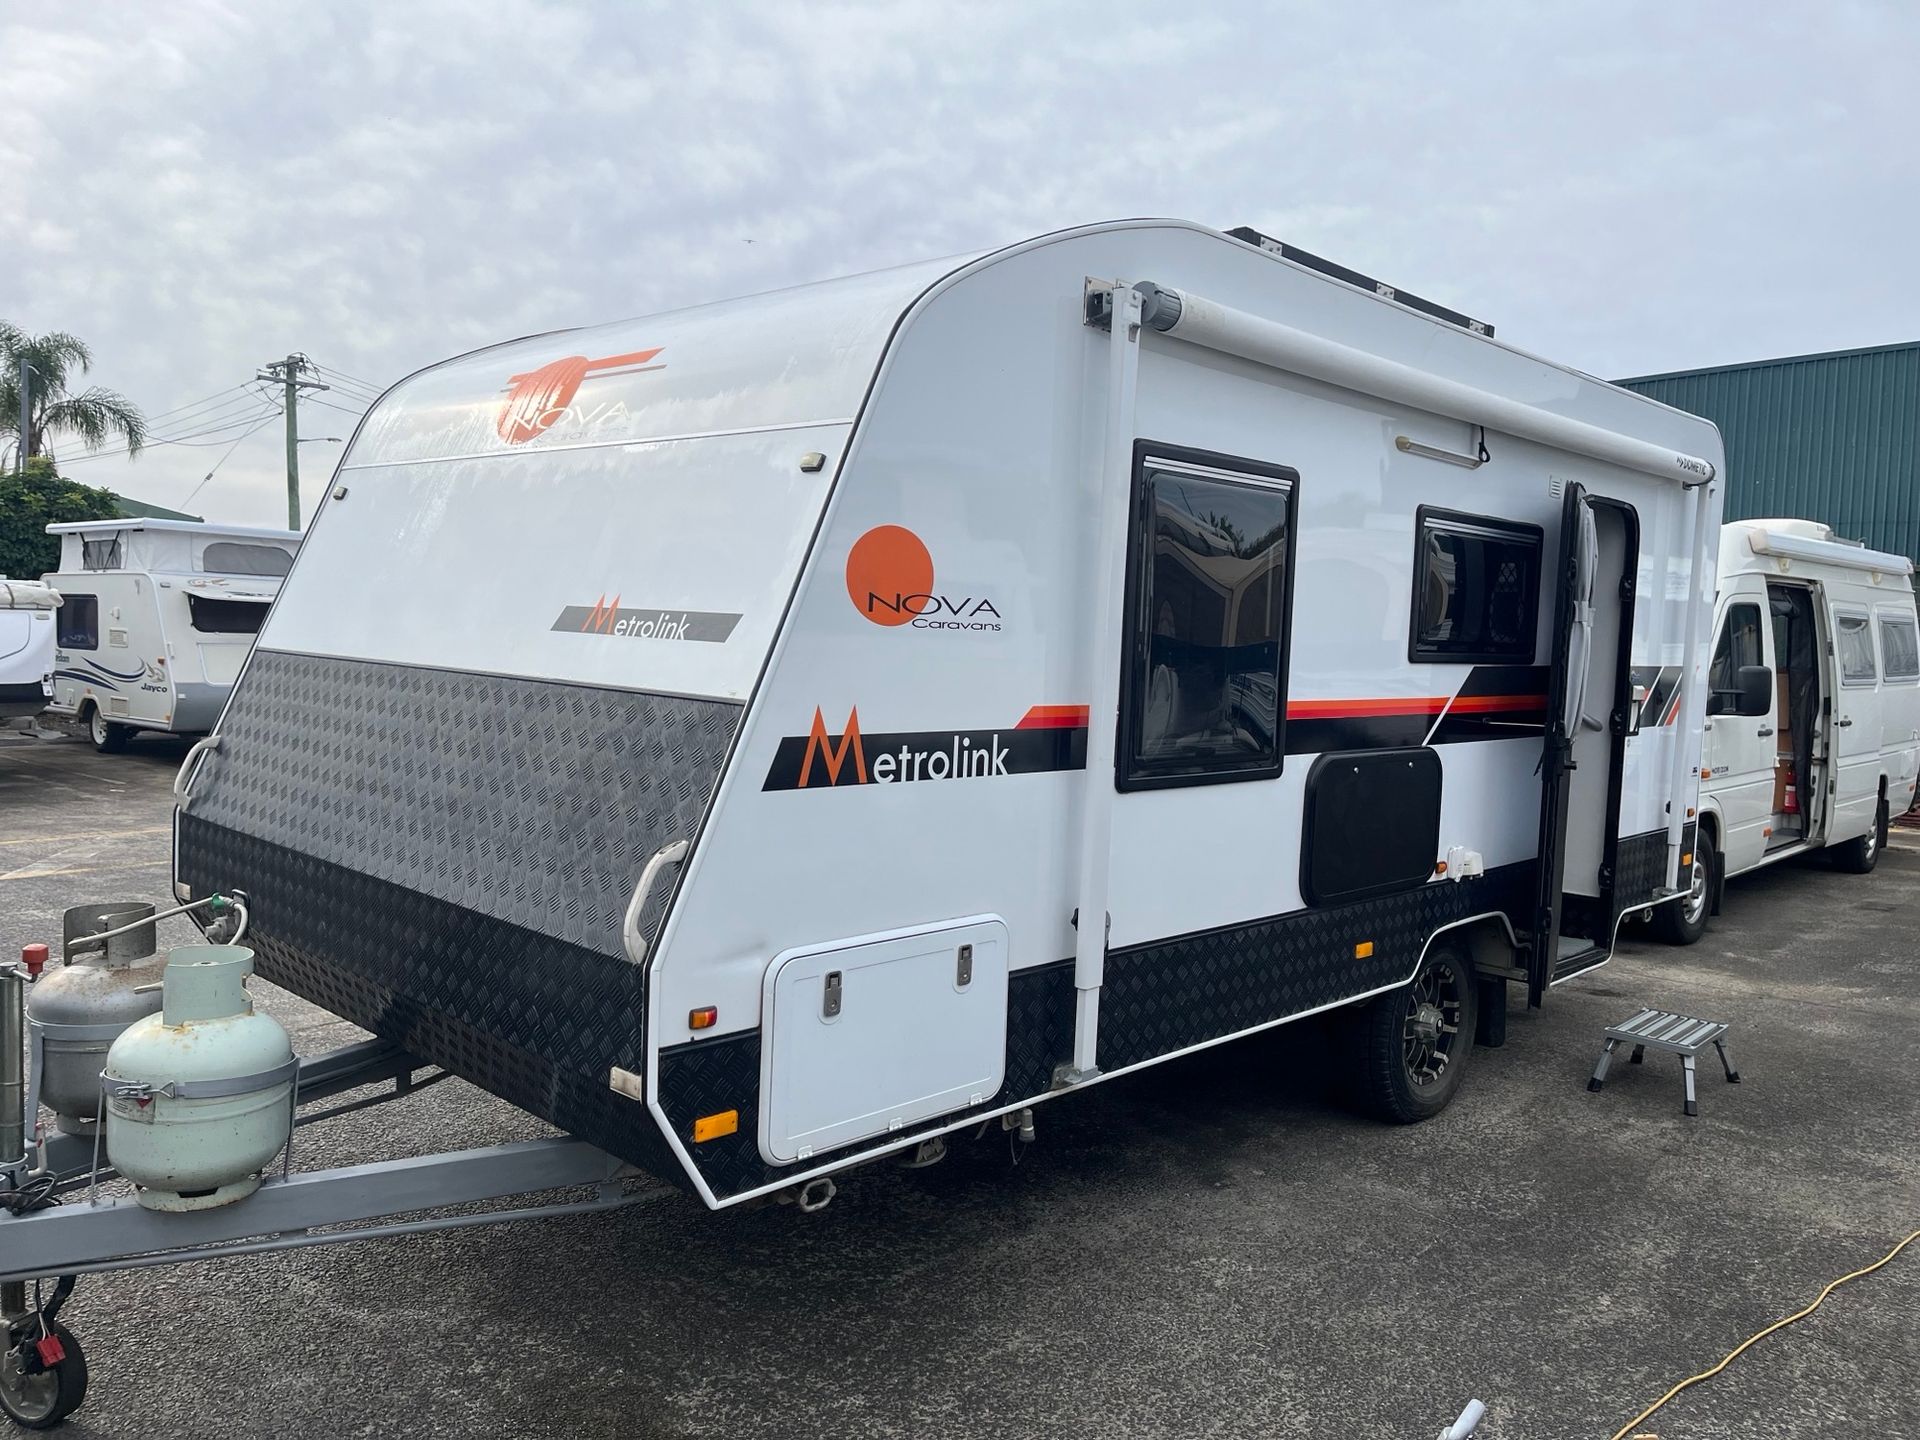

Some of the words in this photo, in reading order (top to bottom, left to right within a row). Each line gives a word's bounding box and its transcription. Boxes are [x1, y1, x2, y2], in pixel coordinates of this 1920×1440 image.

[509, 400, 632, 445] NOVA
[580, 592, 690, 641] Metrolink
[867, 591, 1002, 619] NOVA
[911, 618, 1002, 632] Caravans
[140, 682, 168, 693] Jayco
[797, 703, 1010, 788] Metrolink
